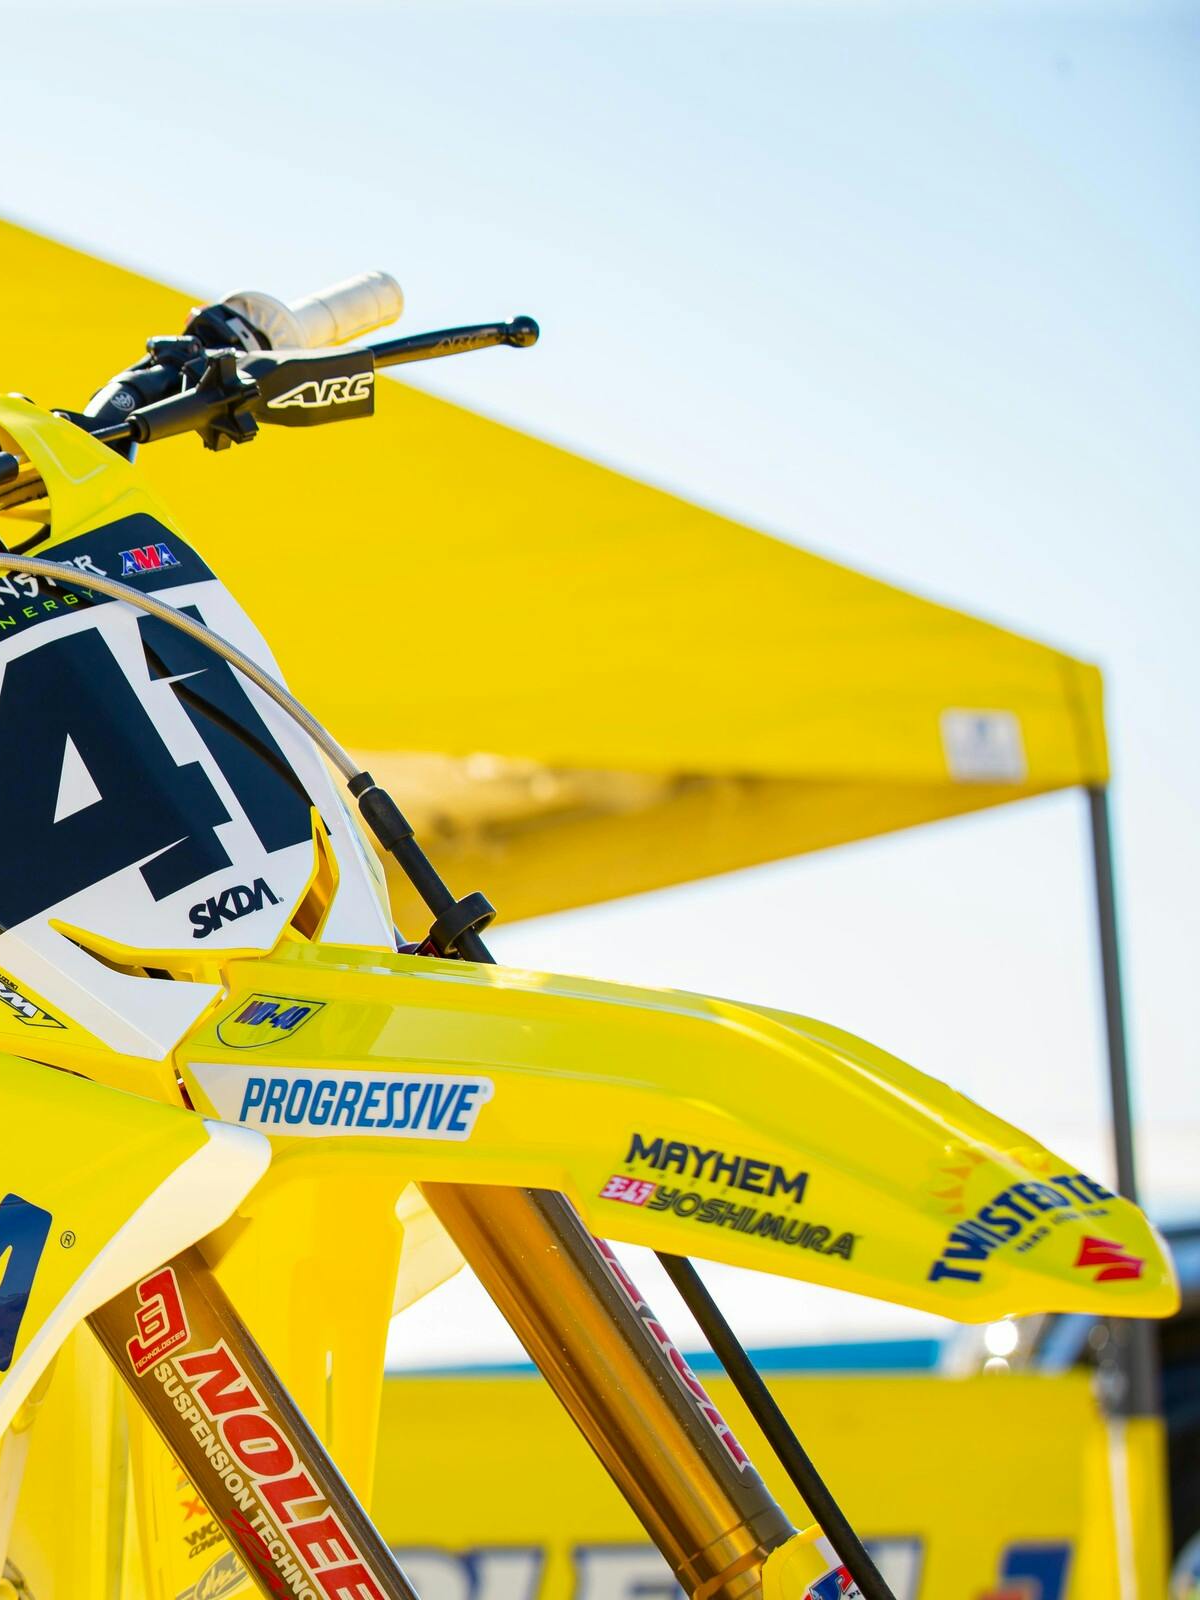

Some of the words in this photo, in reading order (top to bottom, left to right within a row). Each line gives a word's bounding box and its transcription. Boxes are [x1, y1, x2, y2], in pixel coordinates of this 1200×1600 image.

[266, 371, 374, 408] ARC
[118, 542, 180, 576] AMA
[233, 1000, 311, 1031] WD-40
[238, 1077, 480, 1132] PROGRESSIVE
[624, 1132, 809, 1204] MAYHEM
[647, 1185, 855, 1261] YOSHIMURA
[928, 1181, 1072, 1283] TWISTED
[135, 1329, 186, 1369] TECHNOLOGIES
[153, 1361, 257, 1512] SUSPENSION
